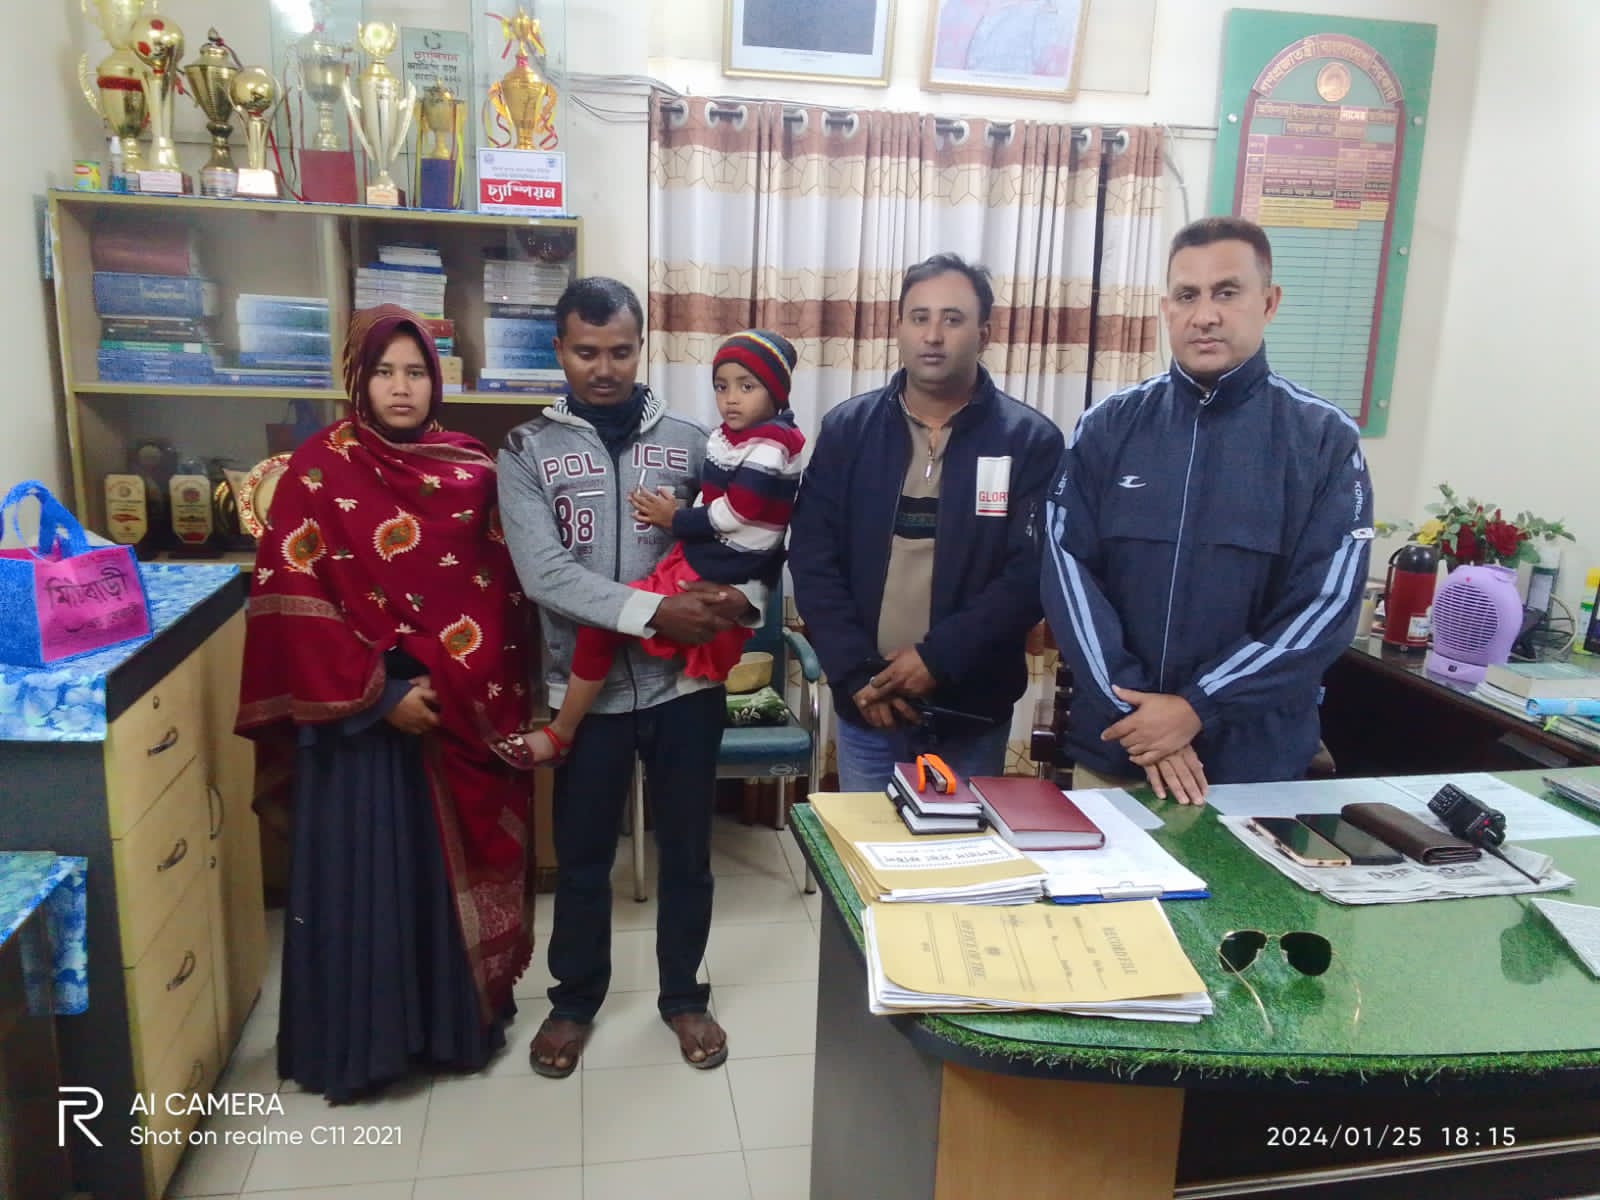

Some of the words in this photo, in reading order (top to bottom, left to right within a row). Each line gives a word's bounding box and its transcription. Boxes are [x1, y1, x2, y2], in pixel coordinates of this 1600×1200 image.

[487, 181, 557, 202] চ্যাম্পিয়ন
[541, 452, 606, 486] POL
[632, 443, 689, 472] ICE
